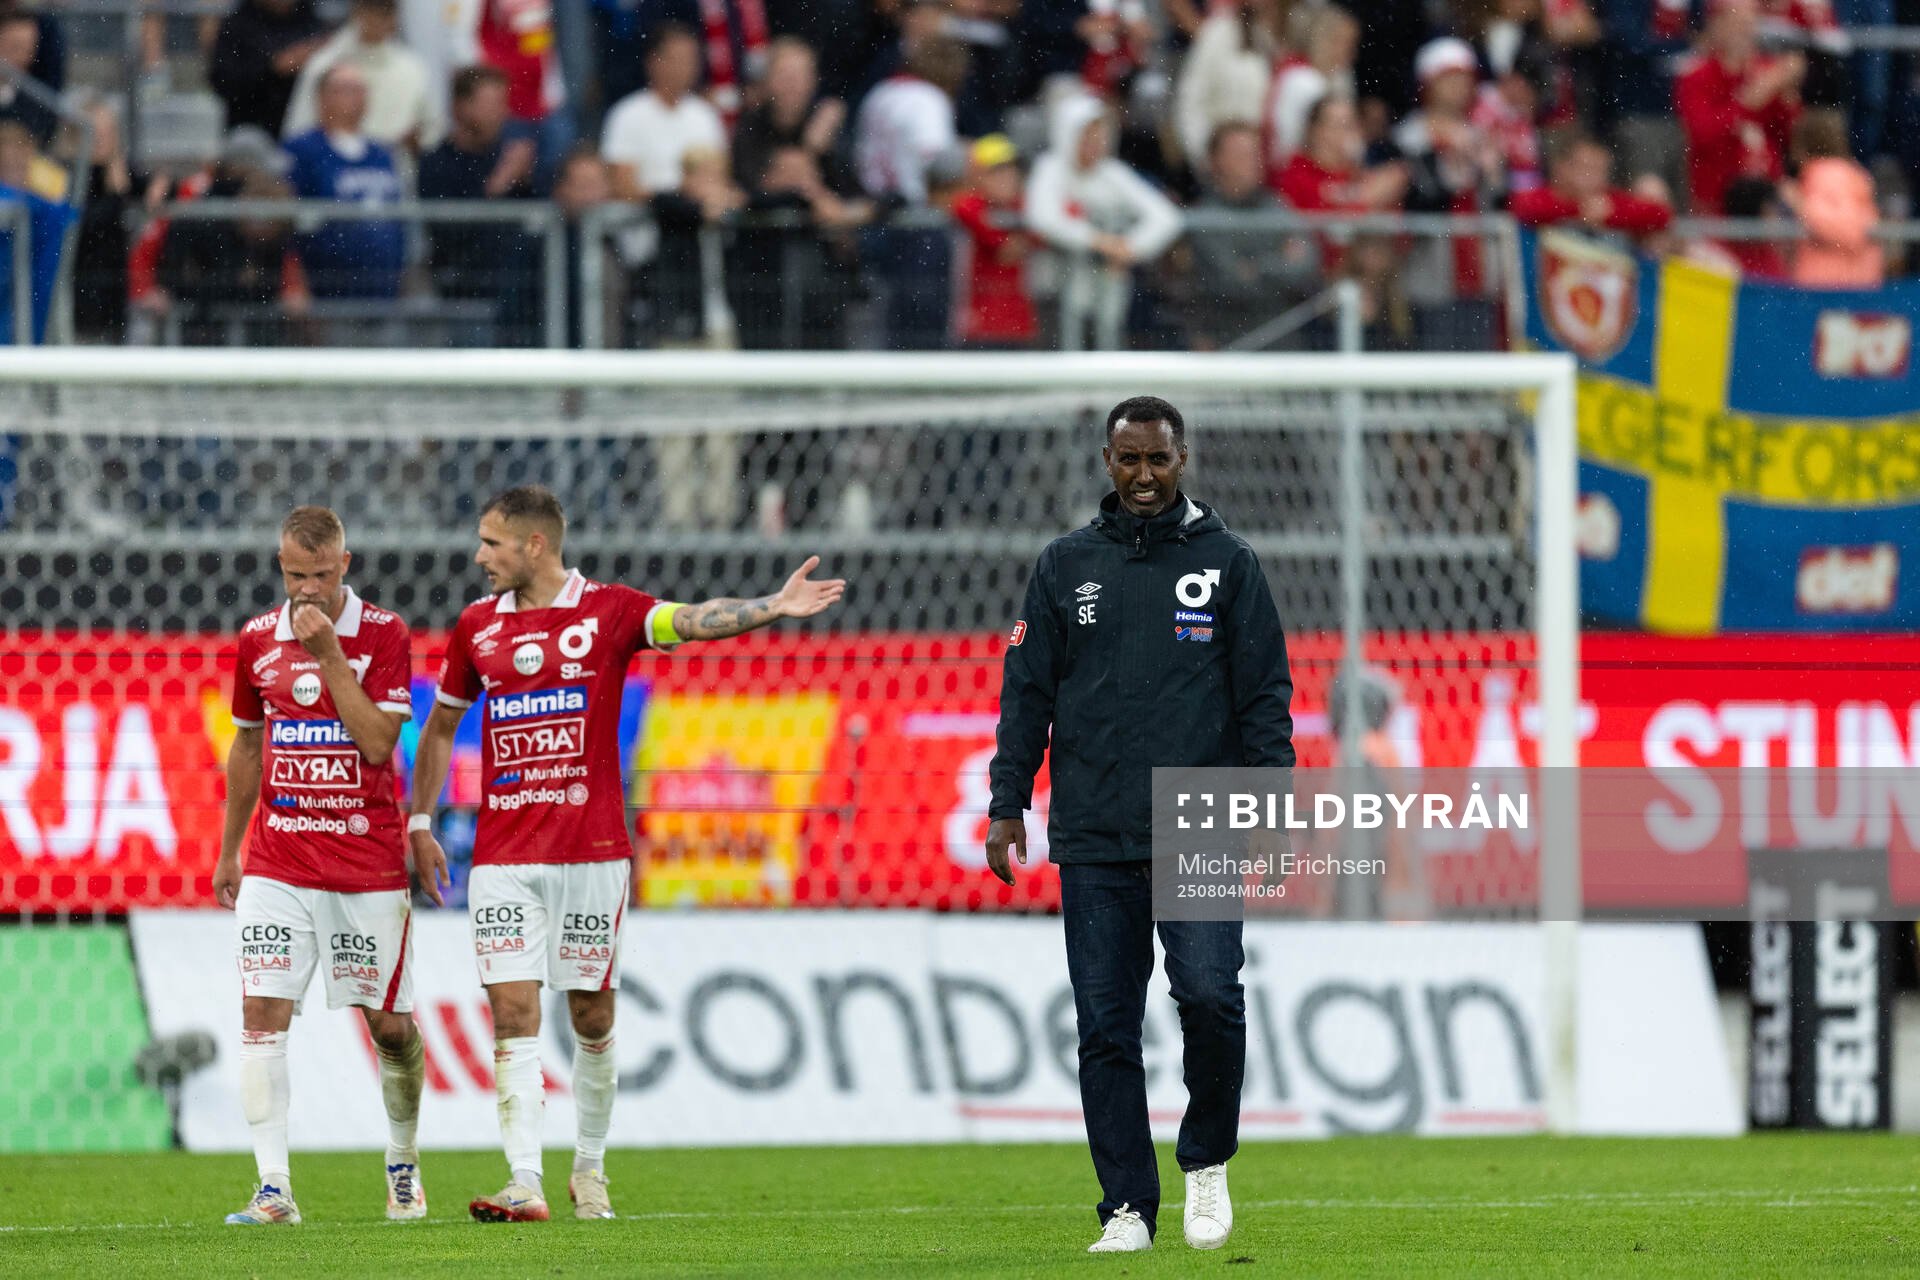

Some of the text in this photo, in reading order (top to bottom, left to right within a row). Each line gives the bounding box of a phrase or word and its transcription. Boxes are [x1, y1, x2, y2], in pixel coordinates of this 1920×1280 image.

[1578, 374, 1920, 498] GERFORS
[246, 611, 278, 632] AVIS
[1078, 603, 1097, 625] SE
[1175, 611, 1213, 622] Helmia
[490, 689, 584, 720] Helmia
[0, 701, 178, 862] RJA
[524, 763, 588, 782] Munkfors
[1642, 697, 1920, 854] STUN
[299, 794, 365, 810] Munkfors
[475, 906, 524, 925] CEOS
[563, 913, 610, 931] CEOS
[241, 925, 292, 942] CEOS
[330, 933, 377, 952] CEOS
[475, 938, 525, 953] D-LAB
[559, 946, 610, 958] D-LAB
[242, 957, 292, 969] D-LAB
[332, 965, 380, 979] D-LAB
[1816, 881, 1878, 1126] SELECT
